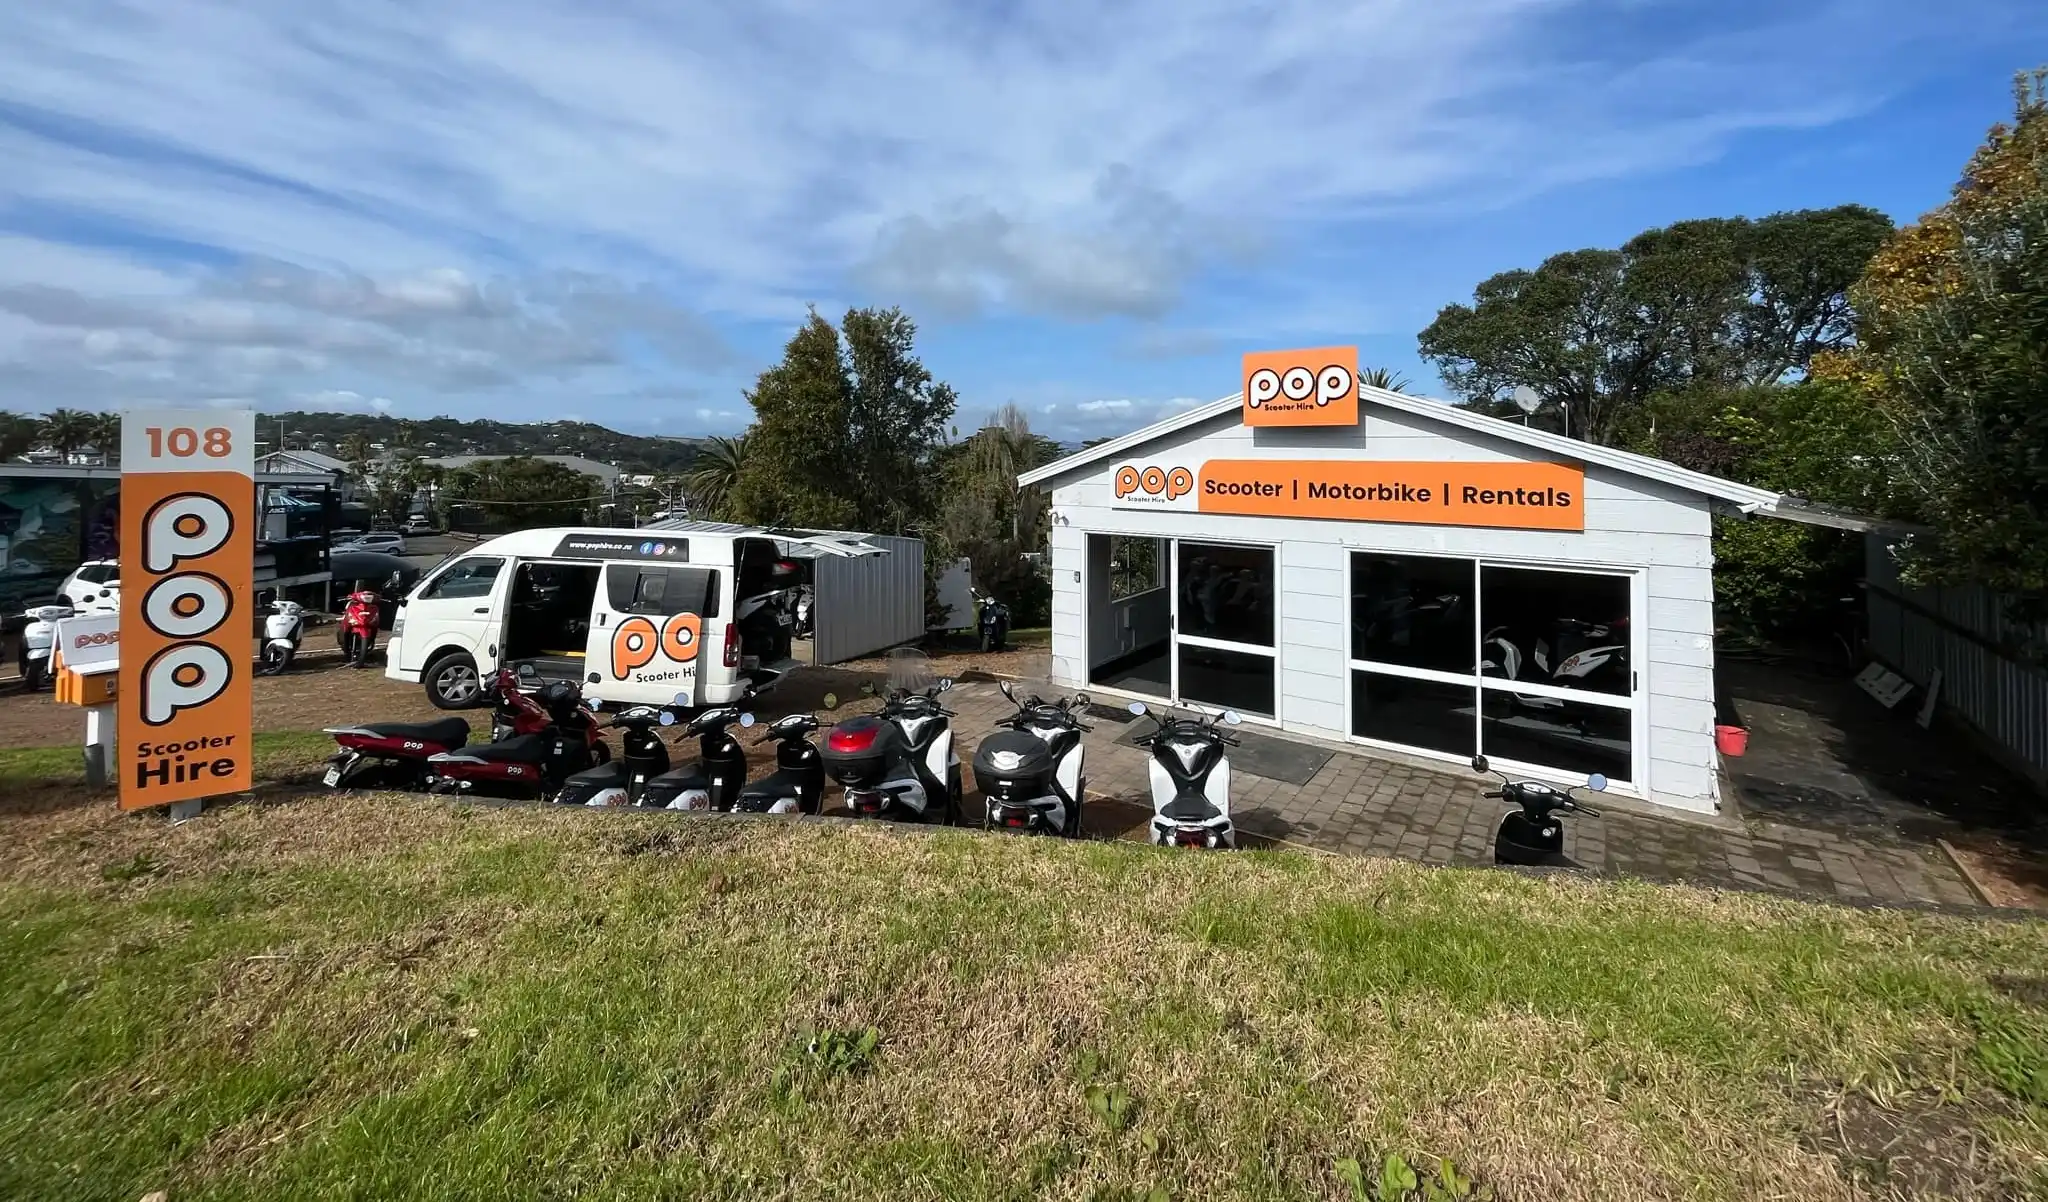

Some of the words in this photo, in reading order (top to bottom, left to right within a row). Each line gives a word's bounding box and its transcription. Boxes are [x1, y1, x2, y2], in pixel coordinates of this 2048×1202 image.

[1248, 364, 1353, 409] pop
[1264, 403, 1294, 411] Scooter
[1296, 402, 1314, 411] Hire
[145, 427, 232, 458] 108
[1115, 465, 1194, 501] pop
[1205, 479, 1283, 497] Scooter
[1308, 481, 1431, 502] Motorbike
[1462, 486, 1571, 507] Rentals
[141, 491, 235, 727] pop
[636, 671, 680, 683] Scooter
[137, 735, 235, 757] Scooter
[403, 741, 424, 750] pop
[137, 754, 235, 788] Hire
[507, 766, 523, 775] pop
